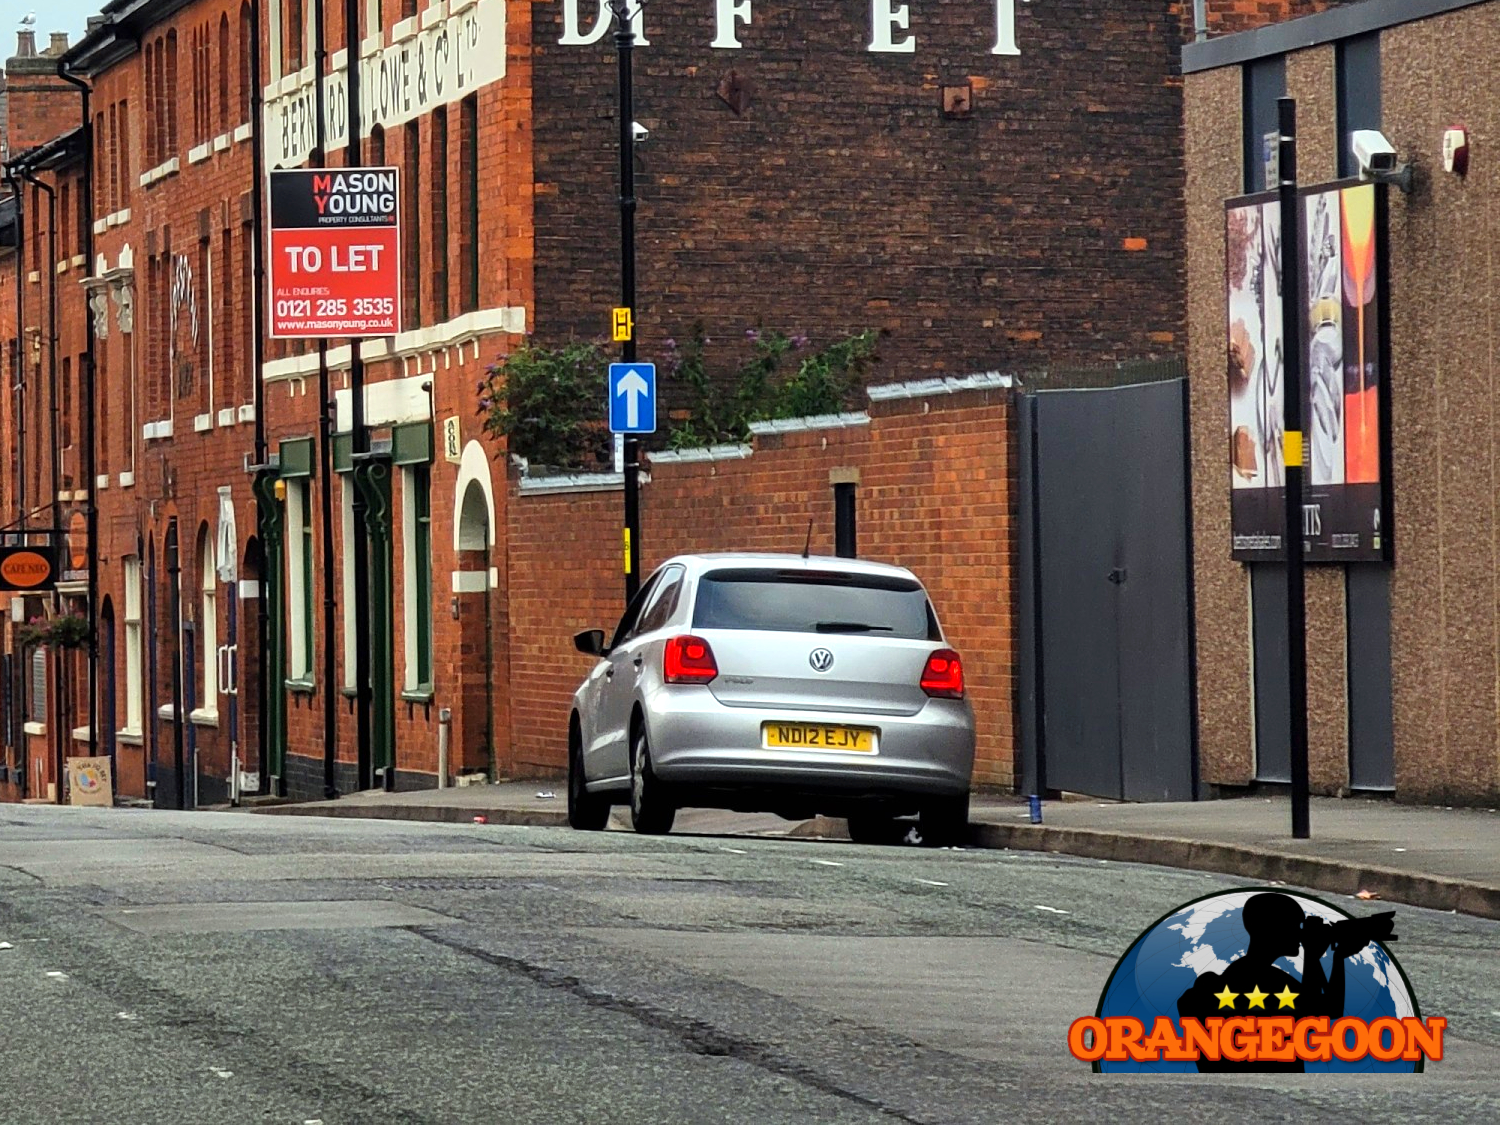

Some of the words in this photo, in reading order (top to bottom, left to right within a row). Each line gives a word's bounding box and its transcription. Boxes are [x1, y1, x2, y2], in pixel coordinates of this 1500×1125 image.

[283, 81, 346, 160] BERNRD
[418, 40, 428, 107] &
[313, 172, 394, 194] MASON
[314, 194, 395, 215] YOUNG
[318, 215, 348, 224] PROPERTY
[285, 246, 322, 273] TO
[330, 244, 385, 272] LET
[276, 300, 311, 317] 0121
[316, 299, 347, 316] 285
[353, 298, 394, 315] 3535
[277, 317, 394, 331] www.masonyoung.co.uk
[778, 726, 819, 746] ND12
[825, 728, 861, 748] EJY
